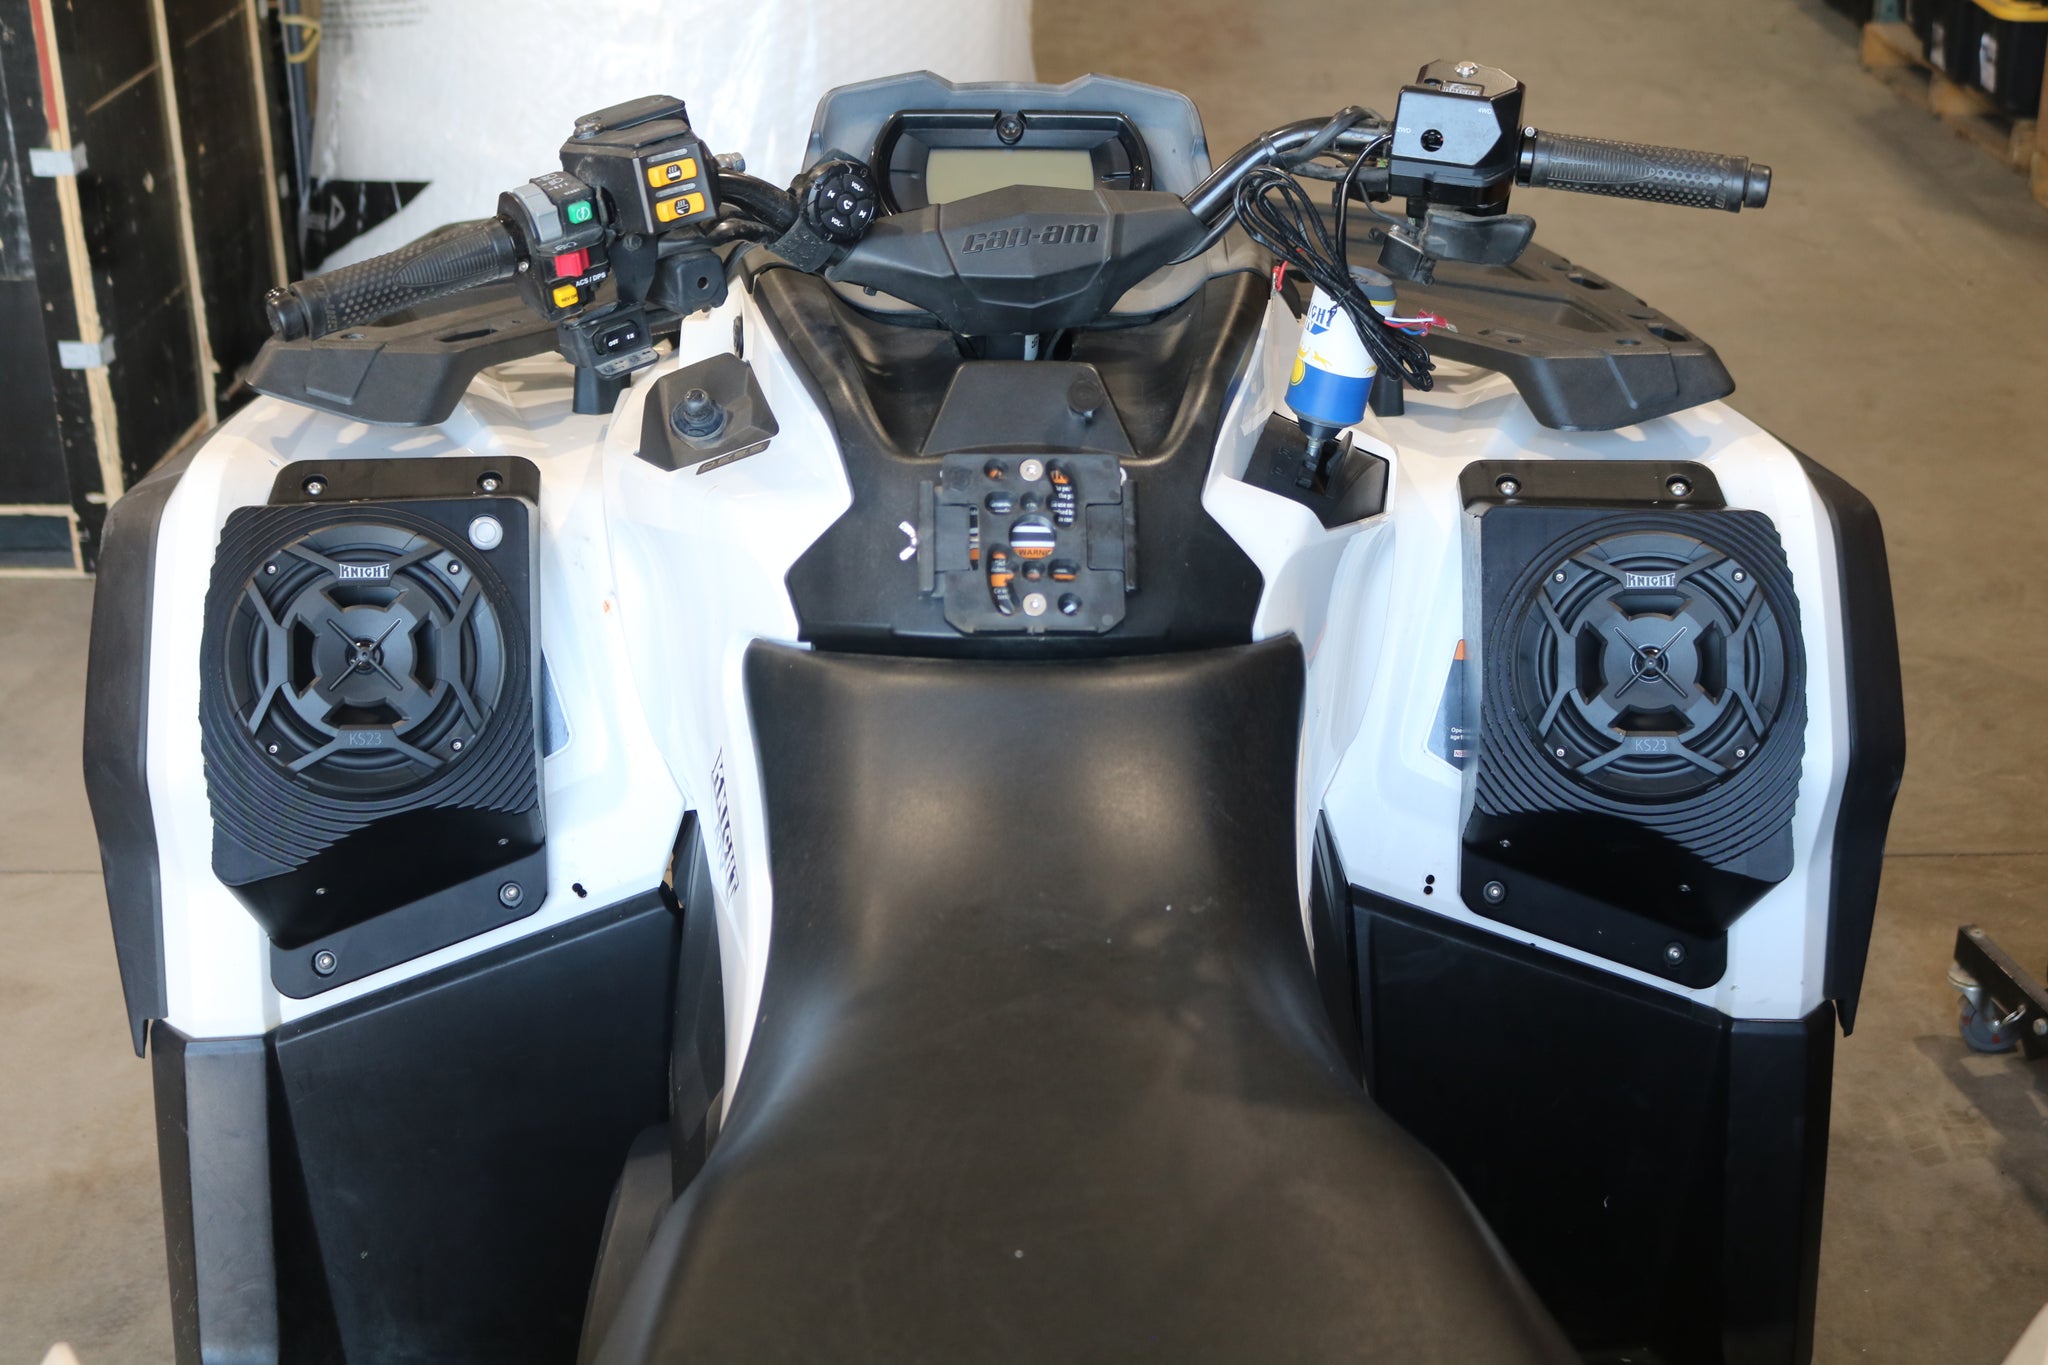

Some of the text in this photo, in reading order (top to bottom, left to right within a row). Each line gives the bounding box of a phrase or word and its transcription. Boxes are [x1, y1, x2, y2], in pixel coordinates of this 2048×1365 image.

[339, 563, 390, 578] KNIGHT
[1626, 572, 1676, 587] KNIGHT
[349, 732, 382, 745] KS23
[1635, 739, 1667, 751] KS23
